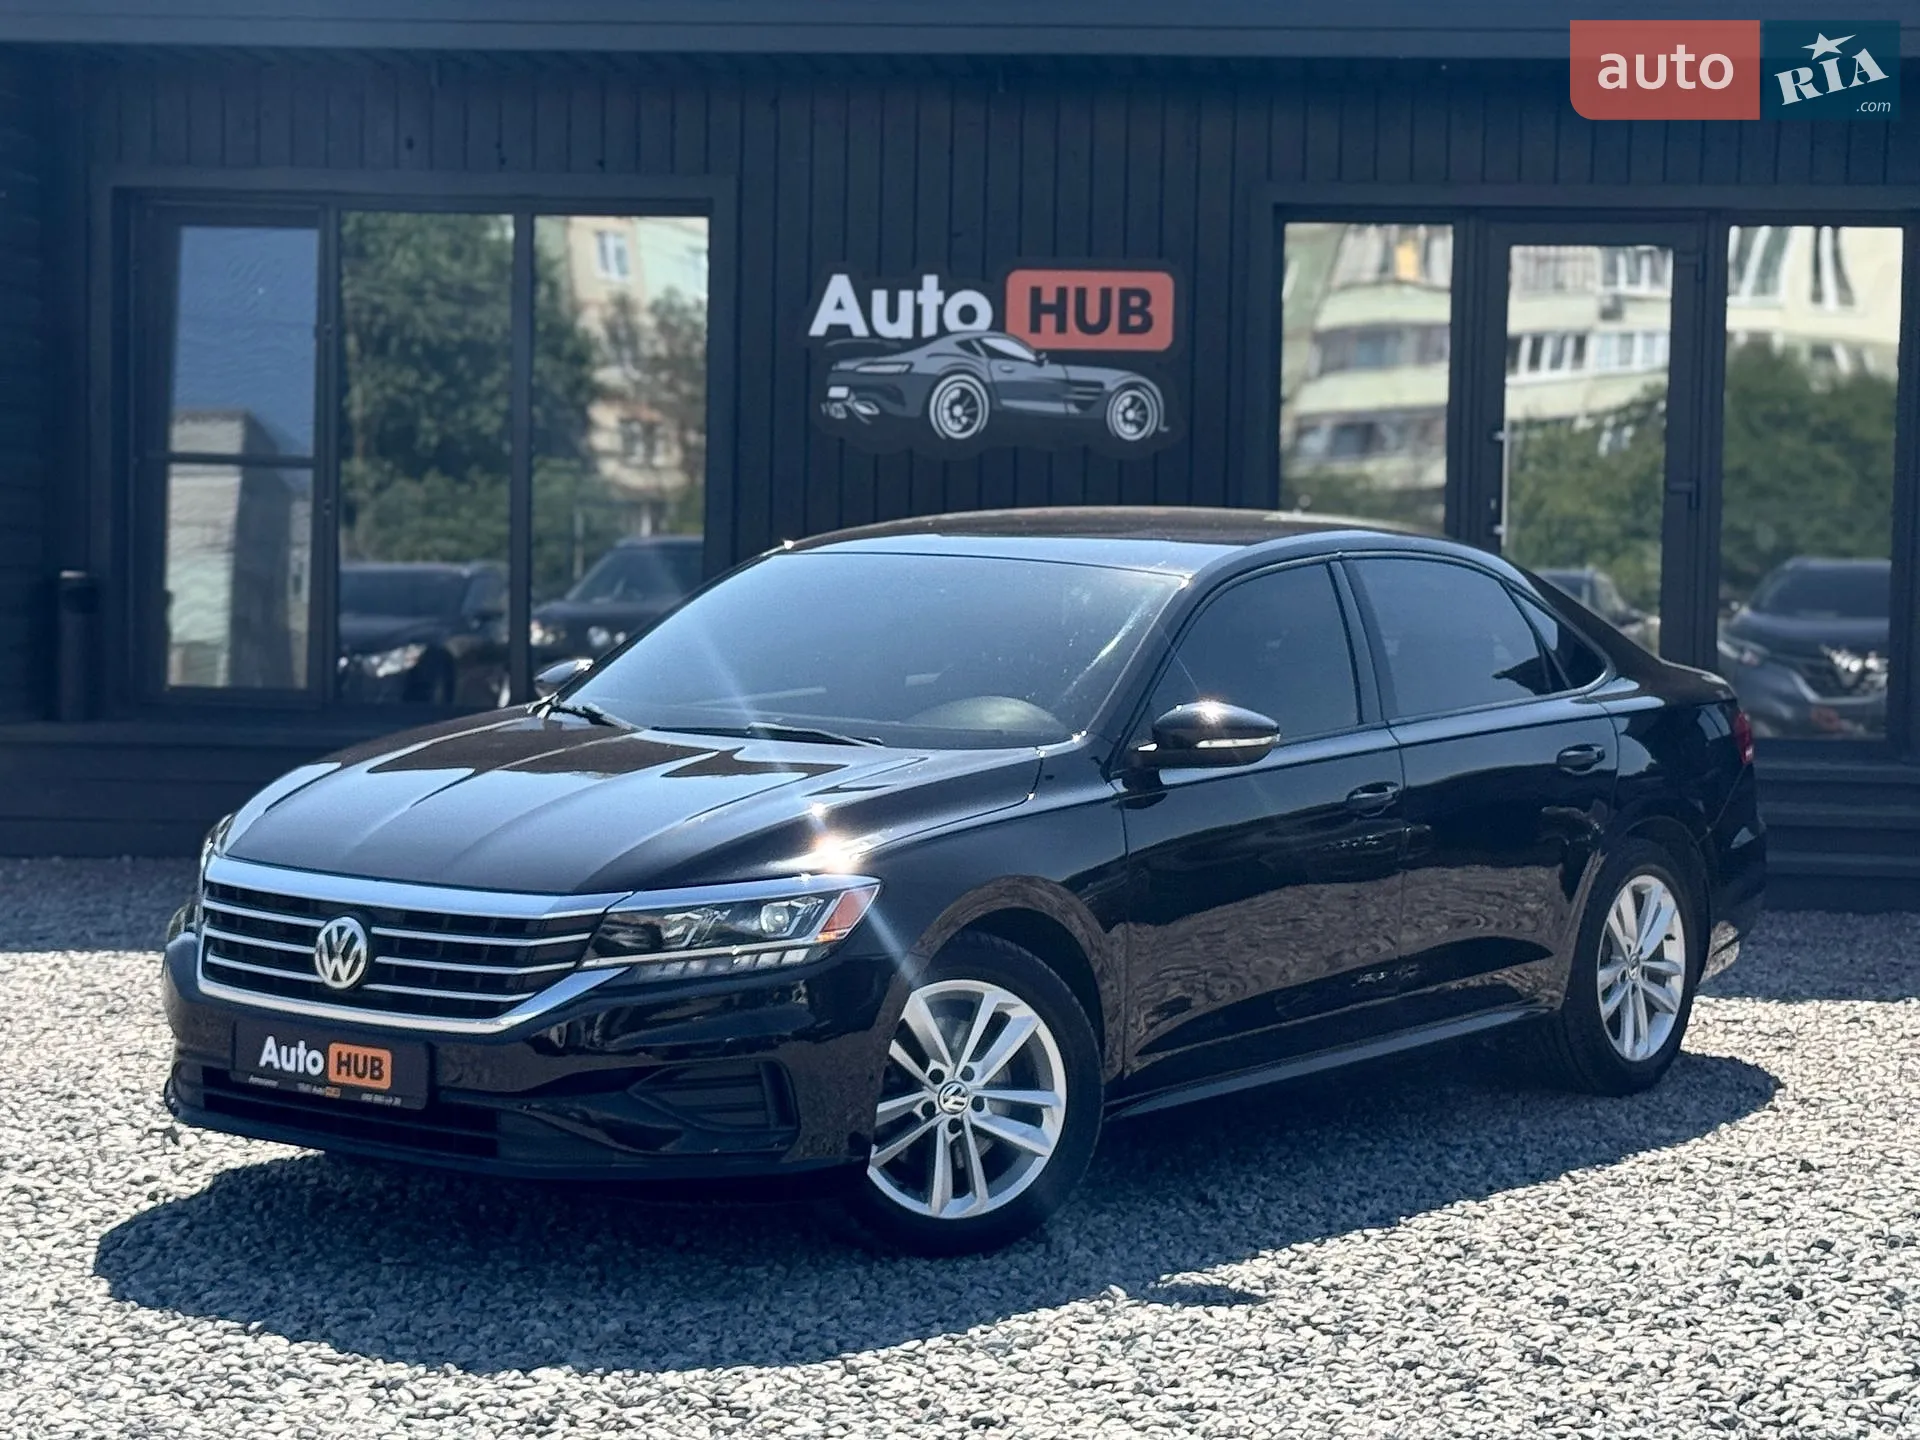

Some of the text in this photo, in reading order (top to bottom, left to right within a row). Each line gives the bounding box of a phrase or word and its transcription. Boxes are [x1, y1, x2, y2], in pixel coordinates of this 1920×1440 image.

[808, 274, 1154, 338] Auto HUB
[315, 916, 367, 989] VW
[258, 1035, 385, 1081] Auto HUB
